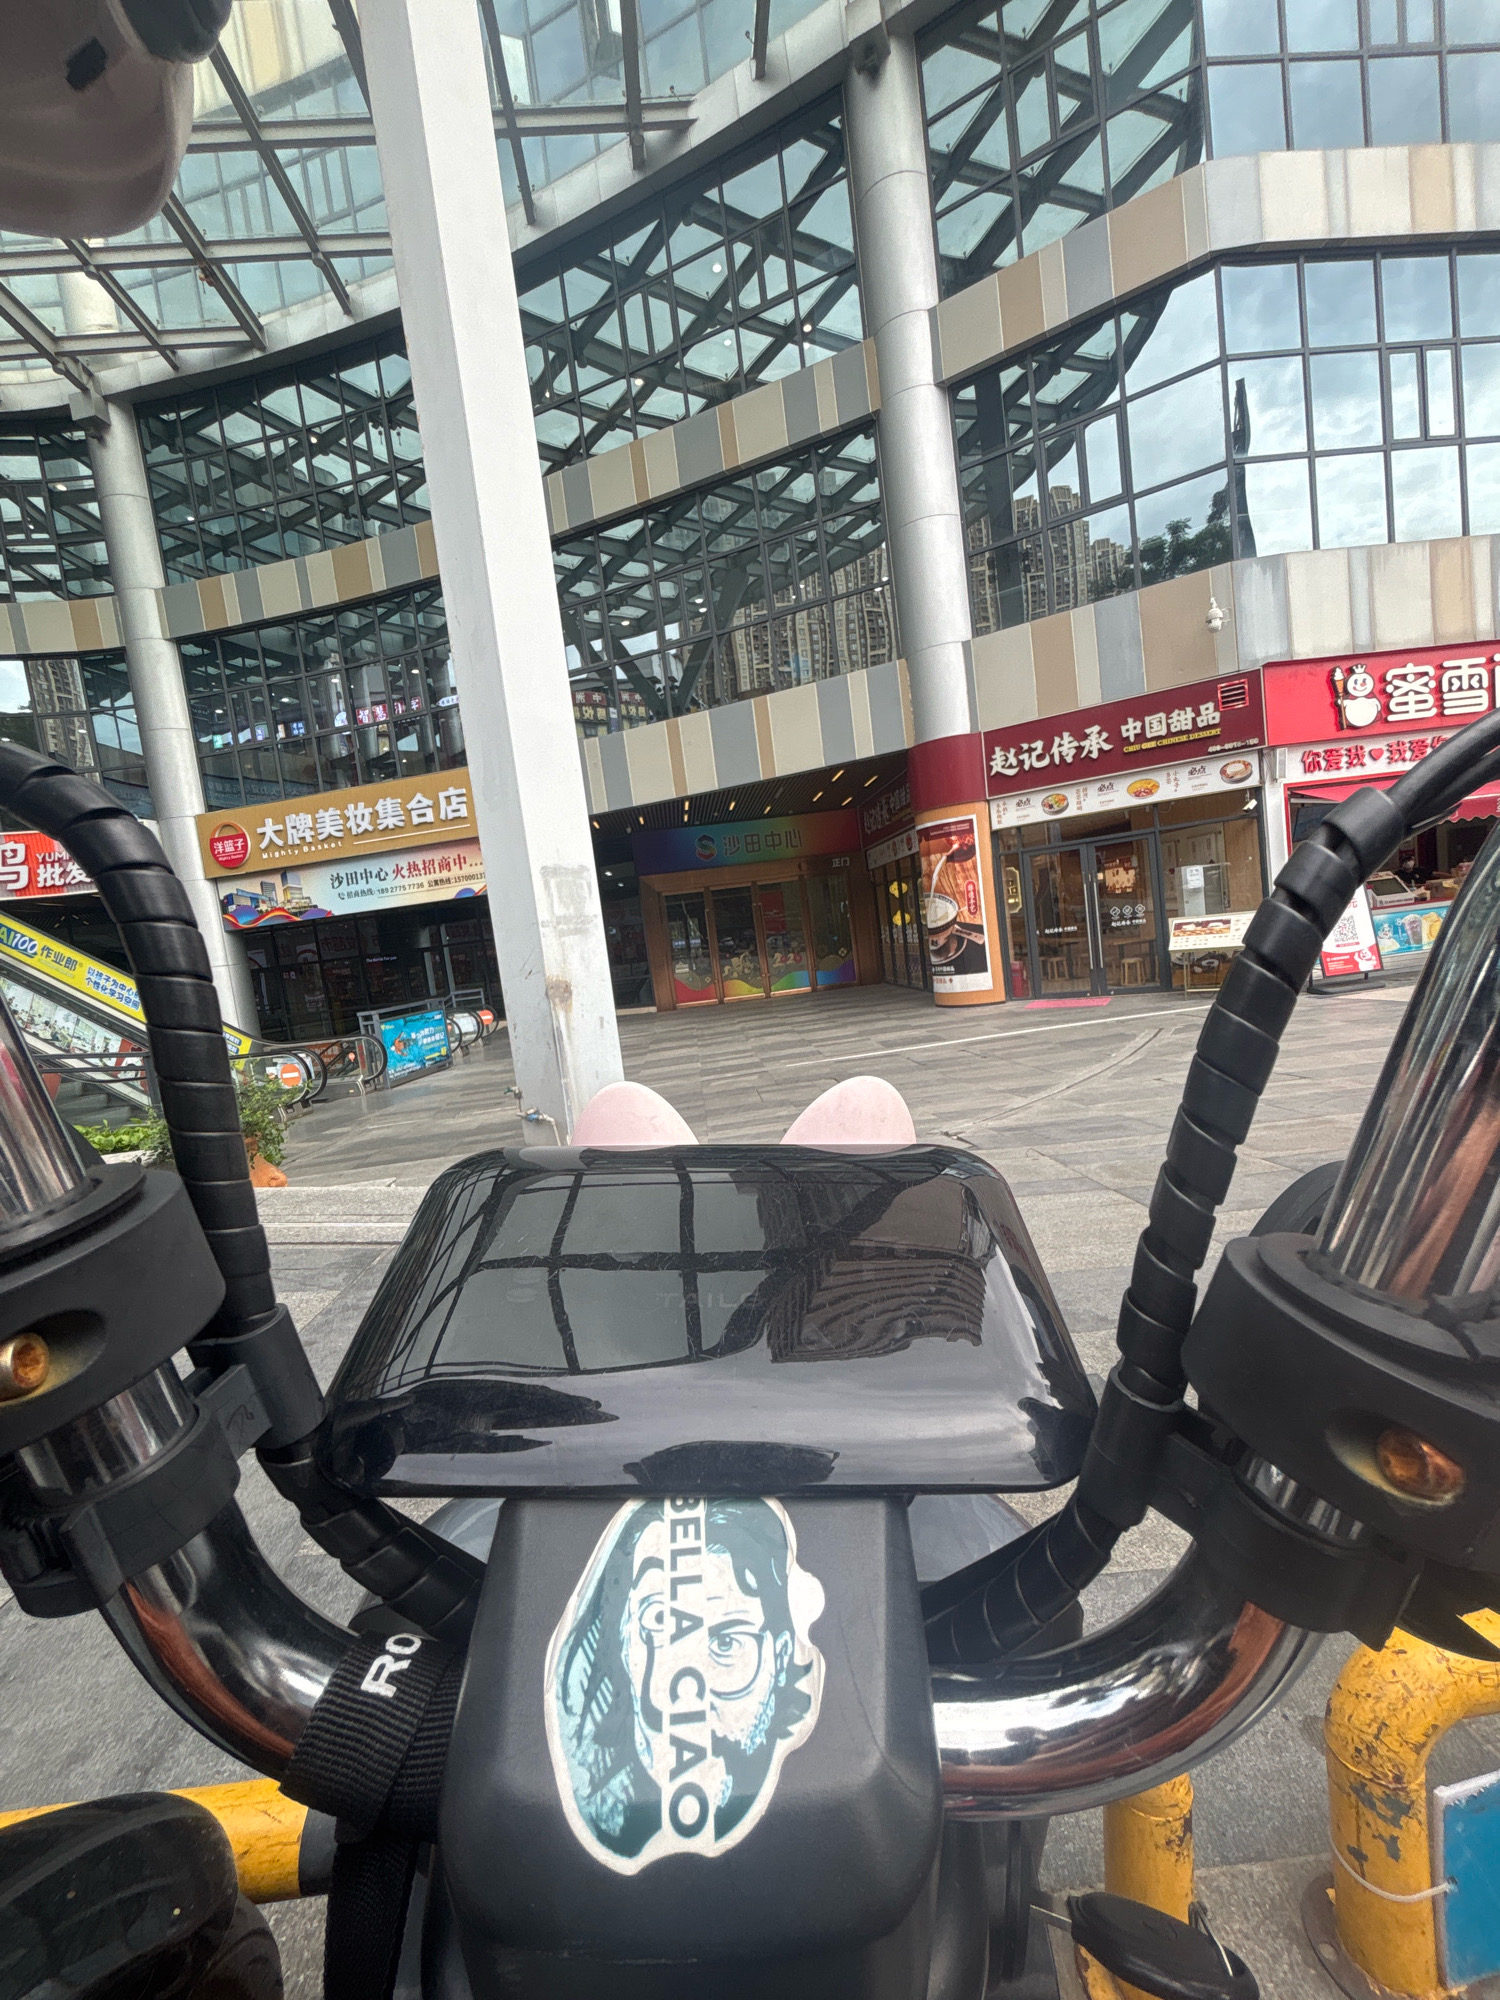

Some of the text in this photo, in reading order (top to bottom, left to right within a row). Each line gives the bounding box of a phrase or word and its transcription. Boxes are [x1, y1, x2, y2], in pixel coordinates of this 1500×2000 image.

[1385, 653, 1500, 722] 蜜雪
[990, 702, 1221, 777] 赵记传承 中国甜品
[1123, 743, 1141, 753] CHIU
[1157, 734, 1189, 747] CHINESE
[1189, 728, 1222, 740] DESSERT
[1187, 765, 1207, 776] 必点
[1302, 744, 1367, 774] 你爱我
[1097, 781, 1115, 793] 必点
[1015, 796, 1032, 808] 必点
[256, 787, 468, 850] 大牌美妆集合店
[213, 838, 246, 853] 洋篮子
[262, 840, 342, 859] Mighty Basket
[722, 828, 803, 857] 沙田中心
[831, 856, 850, 868] 正门
[37, 862, 92, 888] 批发
[330, 867, 389, 889] 沙田中心
[39, 944, 78, 972] 作业郎
[668, 1496, 710, 1840] BELLA CIAO
